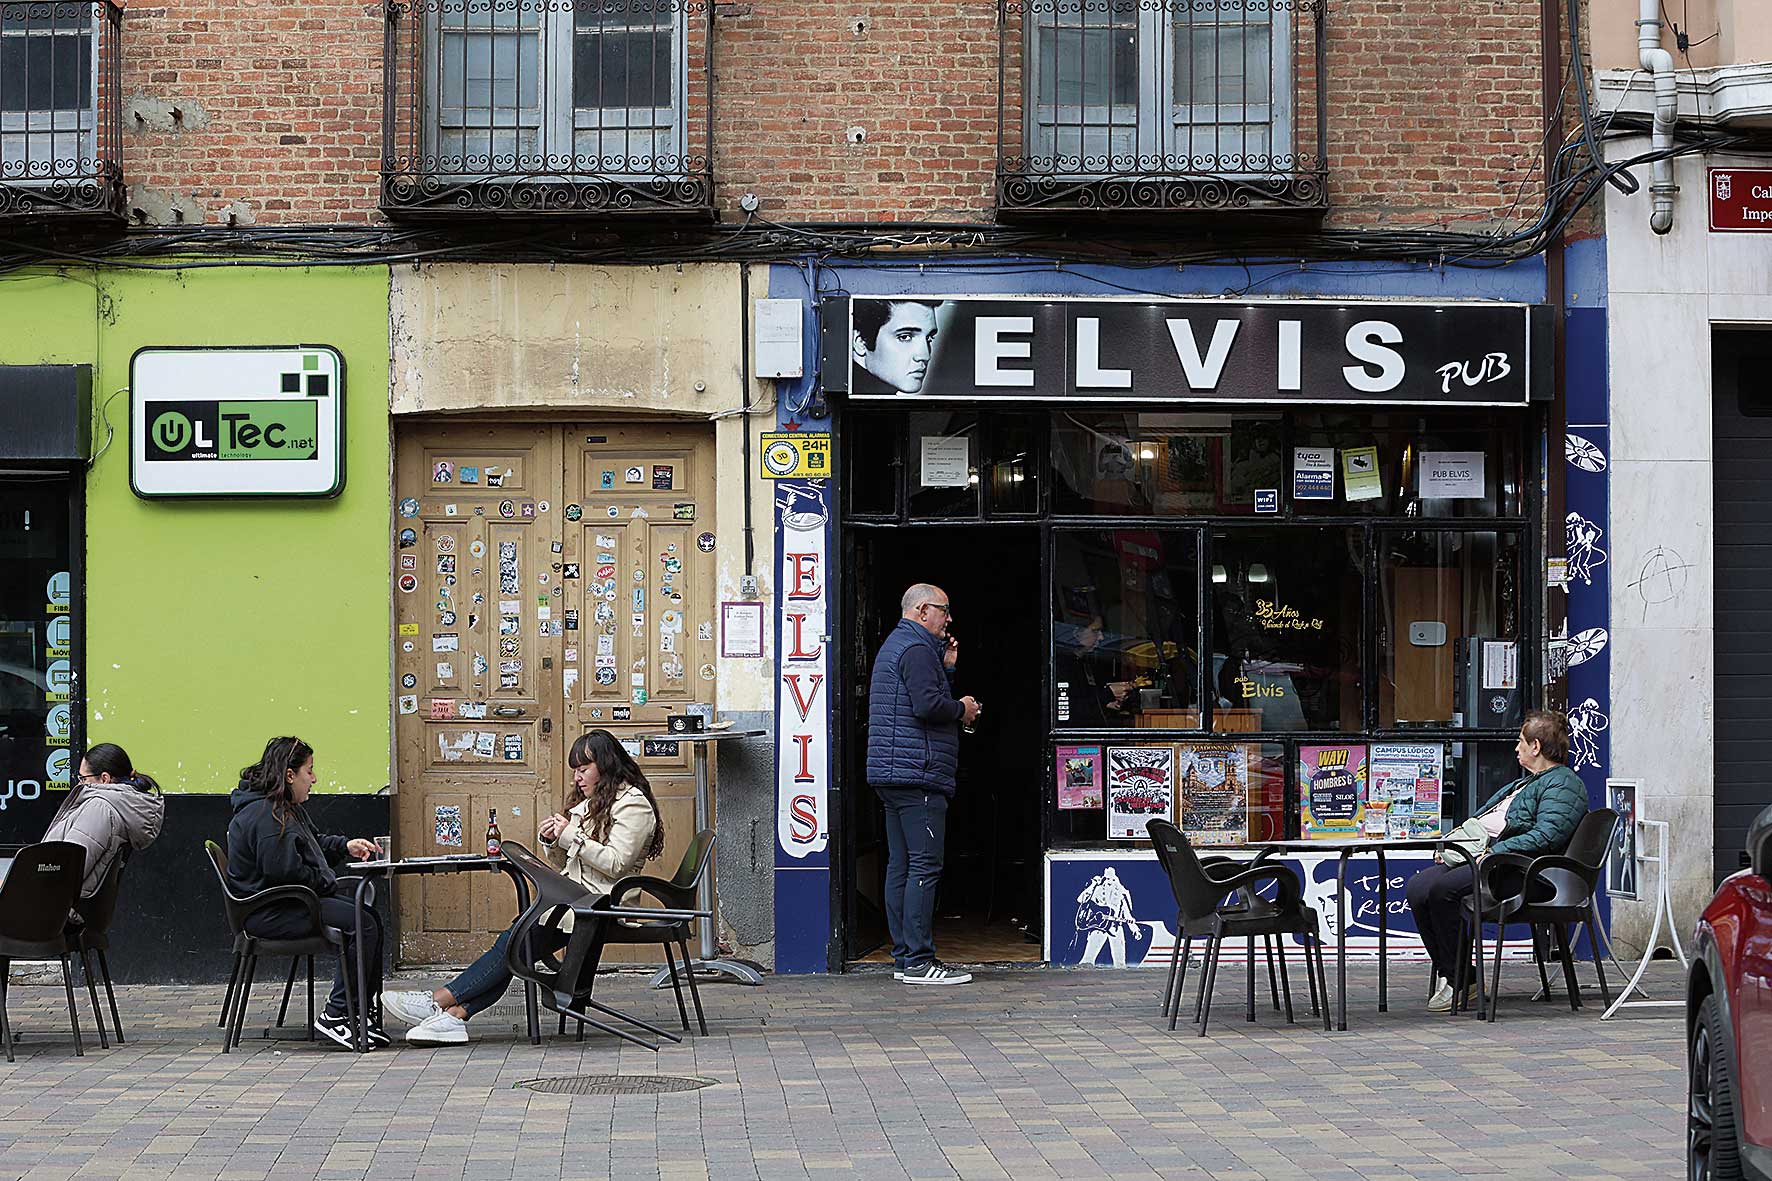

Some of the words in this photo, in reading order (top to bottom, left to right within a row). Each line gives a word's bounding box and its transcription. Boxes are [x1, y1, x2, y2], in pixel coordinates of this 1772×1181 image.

[973, 316, 1406, 394] ELVIS
[1435, 352, 1511, 394] PUB
[802, 441, 828, 450] 24H
[1296, 451, 1321, 461] tyco
[1432, 470, 1448, 478] PUB
[1449, 470, 1470, 478] ELVIS
[1234, 676, 1249, 684] pub
[782, 552, 824, 844] ELVIS
[1242, 682, 1285, 698] Elvis
[1407, 746, 1435, 754] LÚDICO
[1318, 750, 1348, 767] WAY!
[1313, 776, 1346, 791] HOMBRES
[1347, 774, 1353, 785] G
